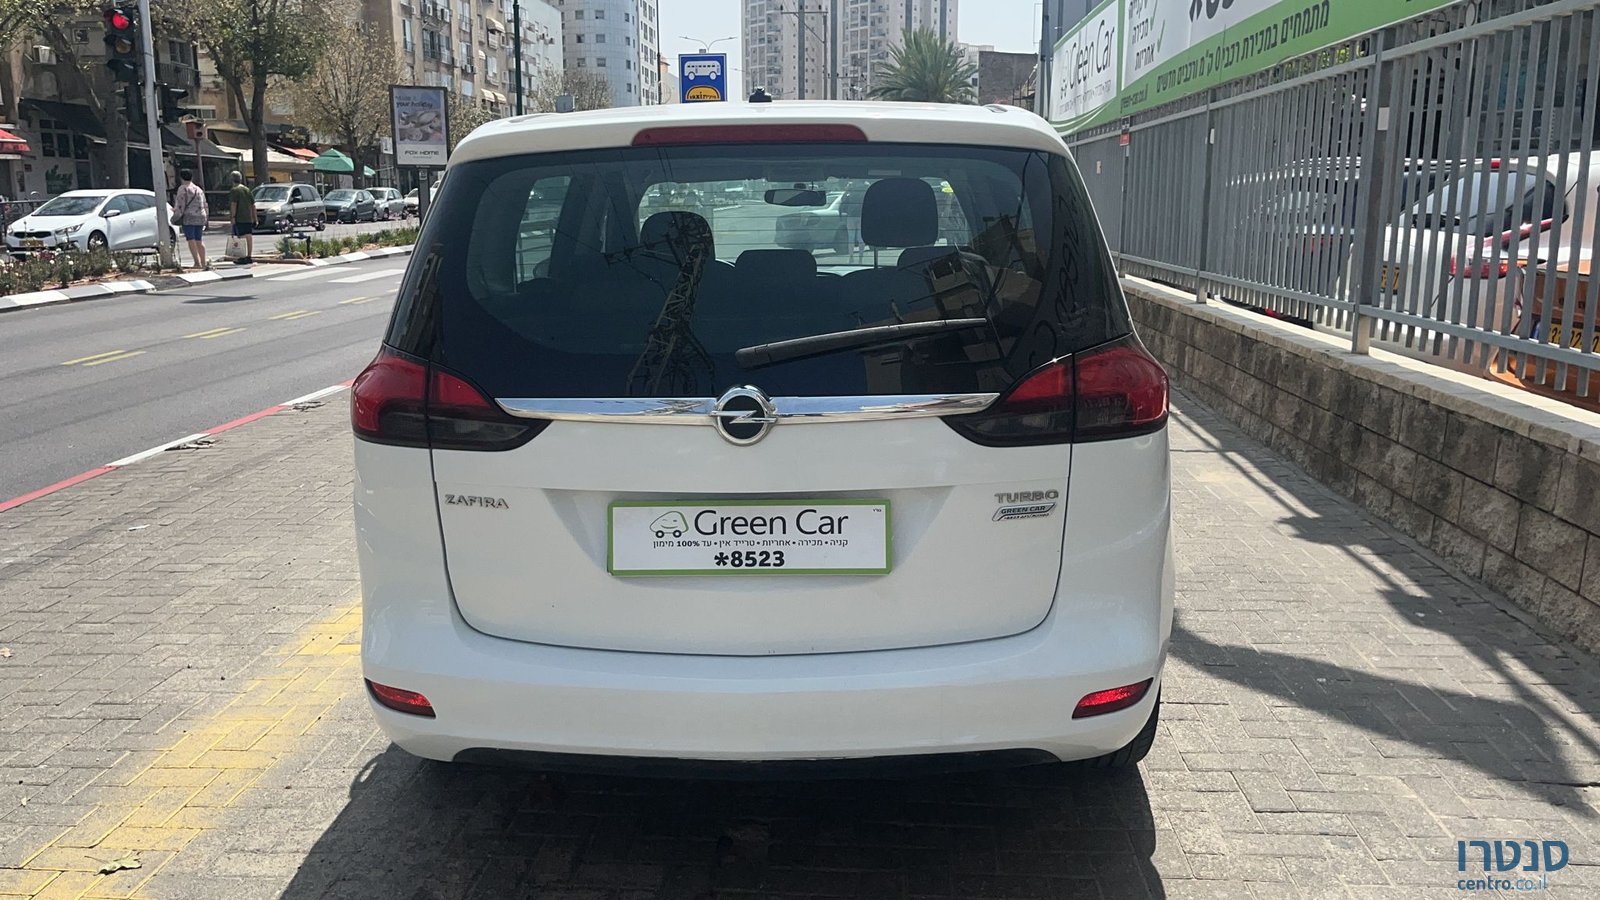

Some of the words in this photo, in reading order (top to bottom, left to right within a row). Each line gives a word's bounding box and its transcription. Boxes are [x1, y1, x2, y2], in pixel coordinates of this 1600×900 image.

[1281, 0, 1330, 45] מתמחים
[1096, 19, 1116, 74] Car
[1241, 24, 1279, 61] במכירת
[1222, 41, 1241, 69] רכבי
[1157, 69, 1176, 94] חדשים
[445, 494, 509, 509] ZAFIRA
[994, 489, 1059, 503] TURBO
[694, 509, 787, 536] Green
[796, 508, 849, 535] Car
[653, 540, 674, 549] מימון
[719, 540, 731, 549] אין
[762, 539, 791, 547] אחריות
[798, 539, 823, 547] מכירה
[829, 539, 848, 548] קניה
